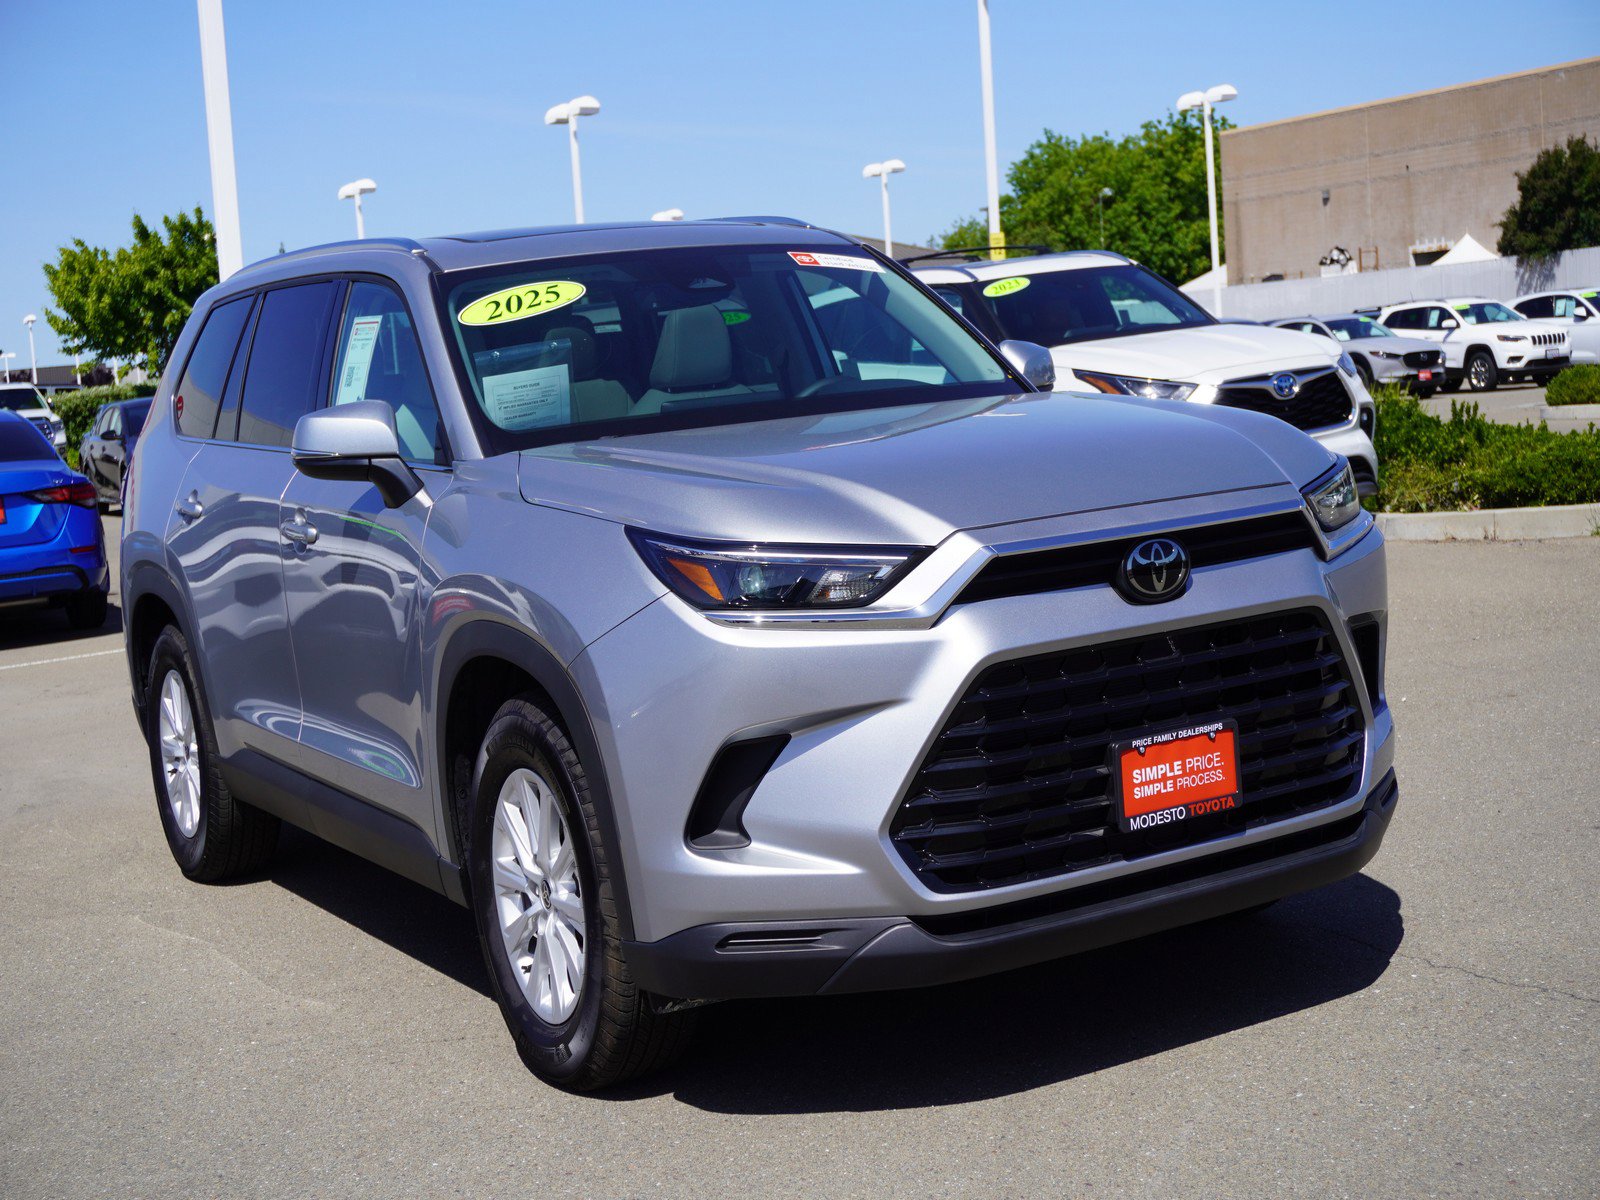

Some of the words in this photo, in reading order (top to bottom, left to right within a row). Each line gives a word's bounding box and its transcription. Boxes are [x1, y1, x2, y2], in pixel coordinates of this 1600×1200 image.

[485, 284, 561, 321] 2025
[1132, 737, 1152, 748] PRICE
[1153, 732, 1177, 744] FAMILY
[1178, 722, 1223, 738] DEALERSHIPS
[1132, 760, 1182, 784] SIMPLE
[1185, 752, 1224, 772] PRICE.
[1133, 780, 1174, 799] SIMPLE
[1176, 769, 1226, 790] PROCESS.
[1130, 806, 1186, 831] MODESTO
[1188, 796, 1235, 816] TOYOTA
